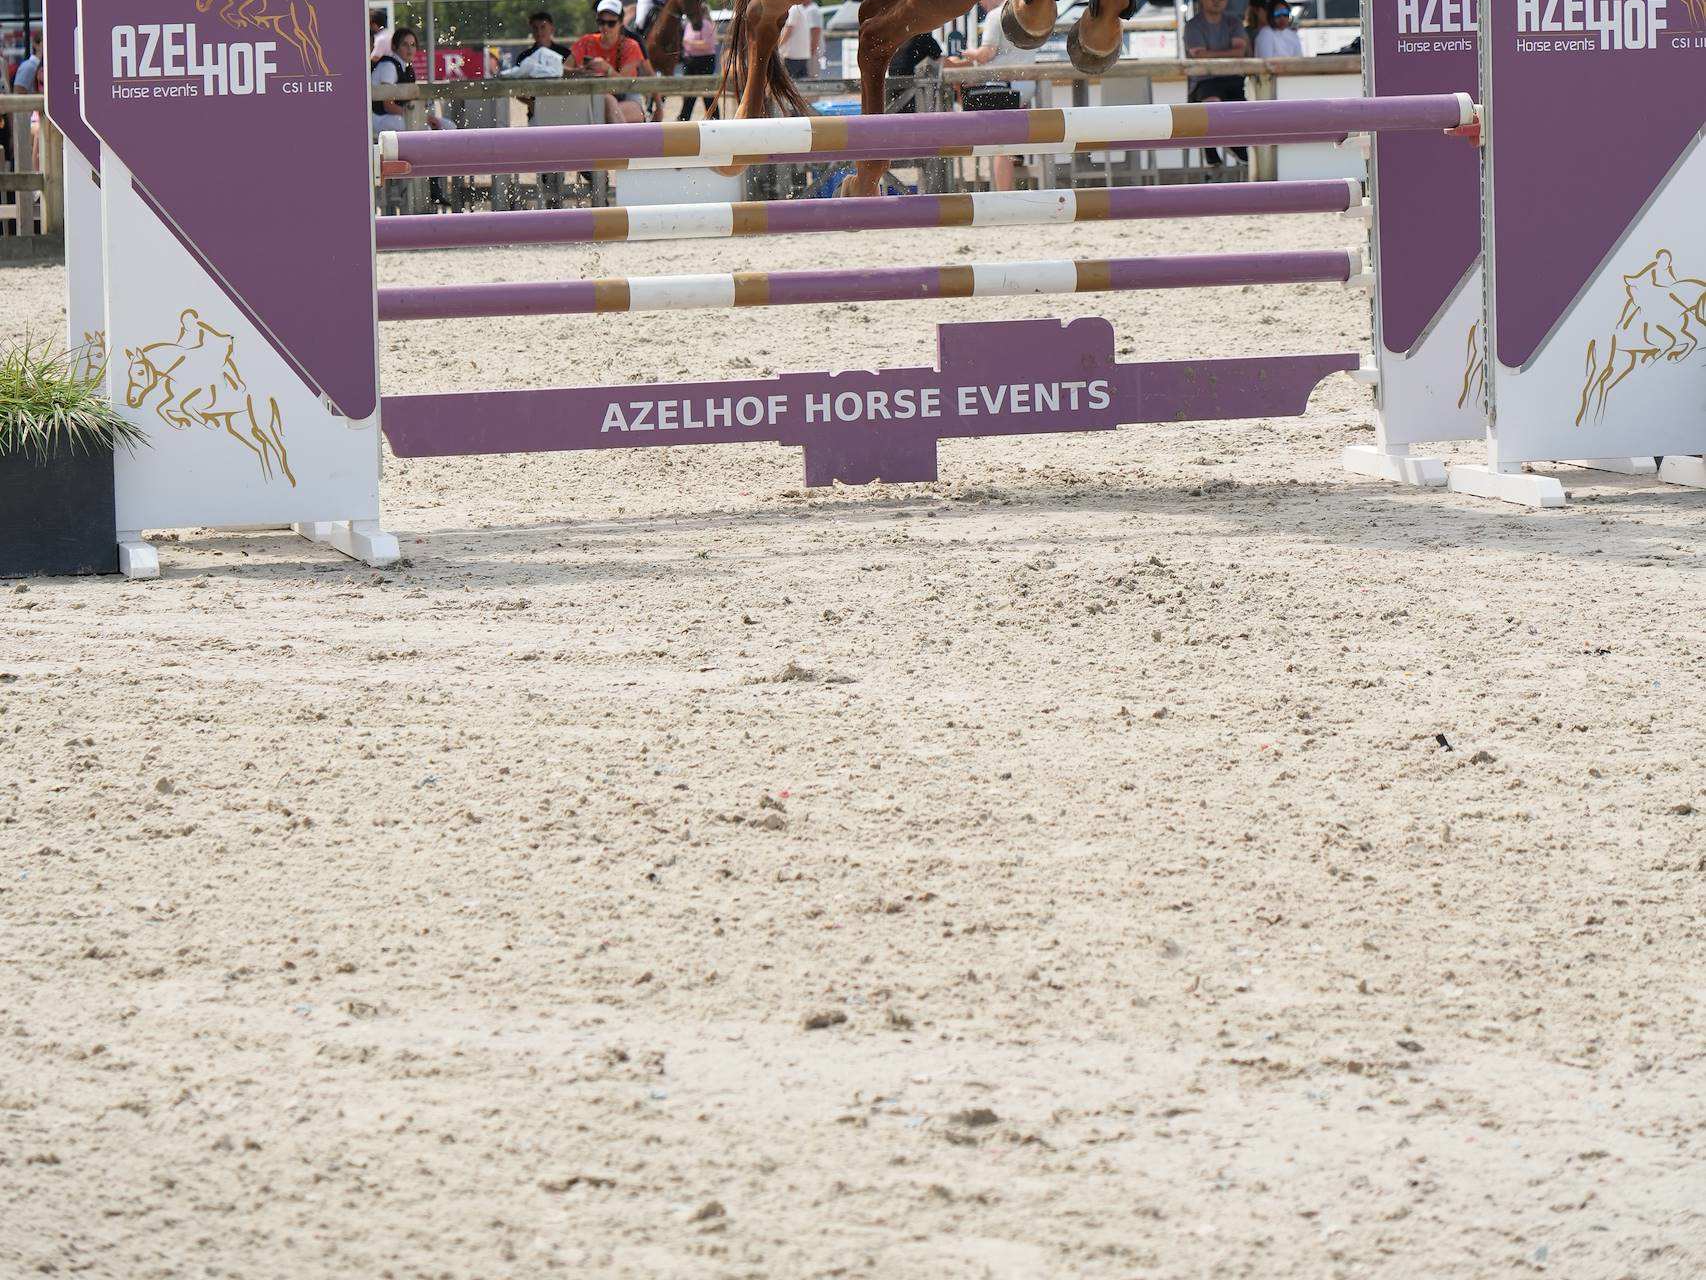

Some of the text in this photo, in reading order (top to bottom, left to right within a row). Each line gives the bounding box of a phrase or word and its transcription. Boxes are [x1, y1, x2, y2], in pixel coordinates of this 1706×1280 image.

[1398, 38, 1472, 53] Horse events
[1517, 38, 1595, 52] Horse events
[1672, 37, 1706, 48] CSI LI
[112, 23, 277, 96] AZELHOF
[112, 83, 198, 98] Horse events
[282, 81, 333, 94] CSI LIER
[601, 379, 1110, 433] AZELHOF HORSE EVENTS
